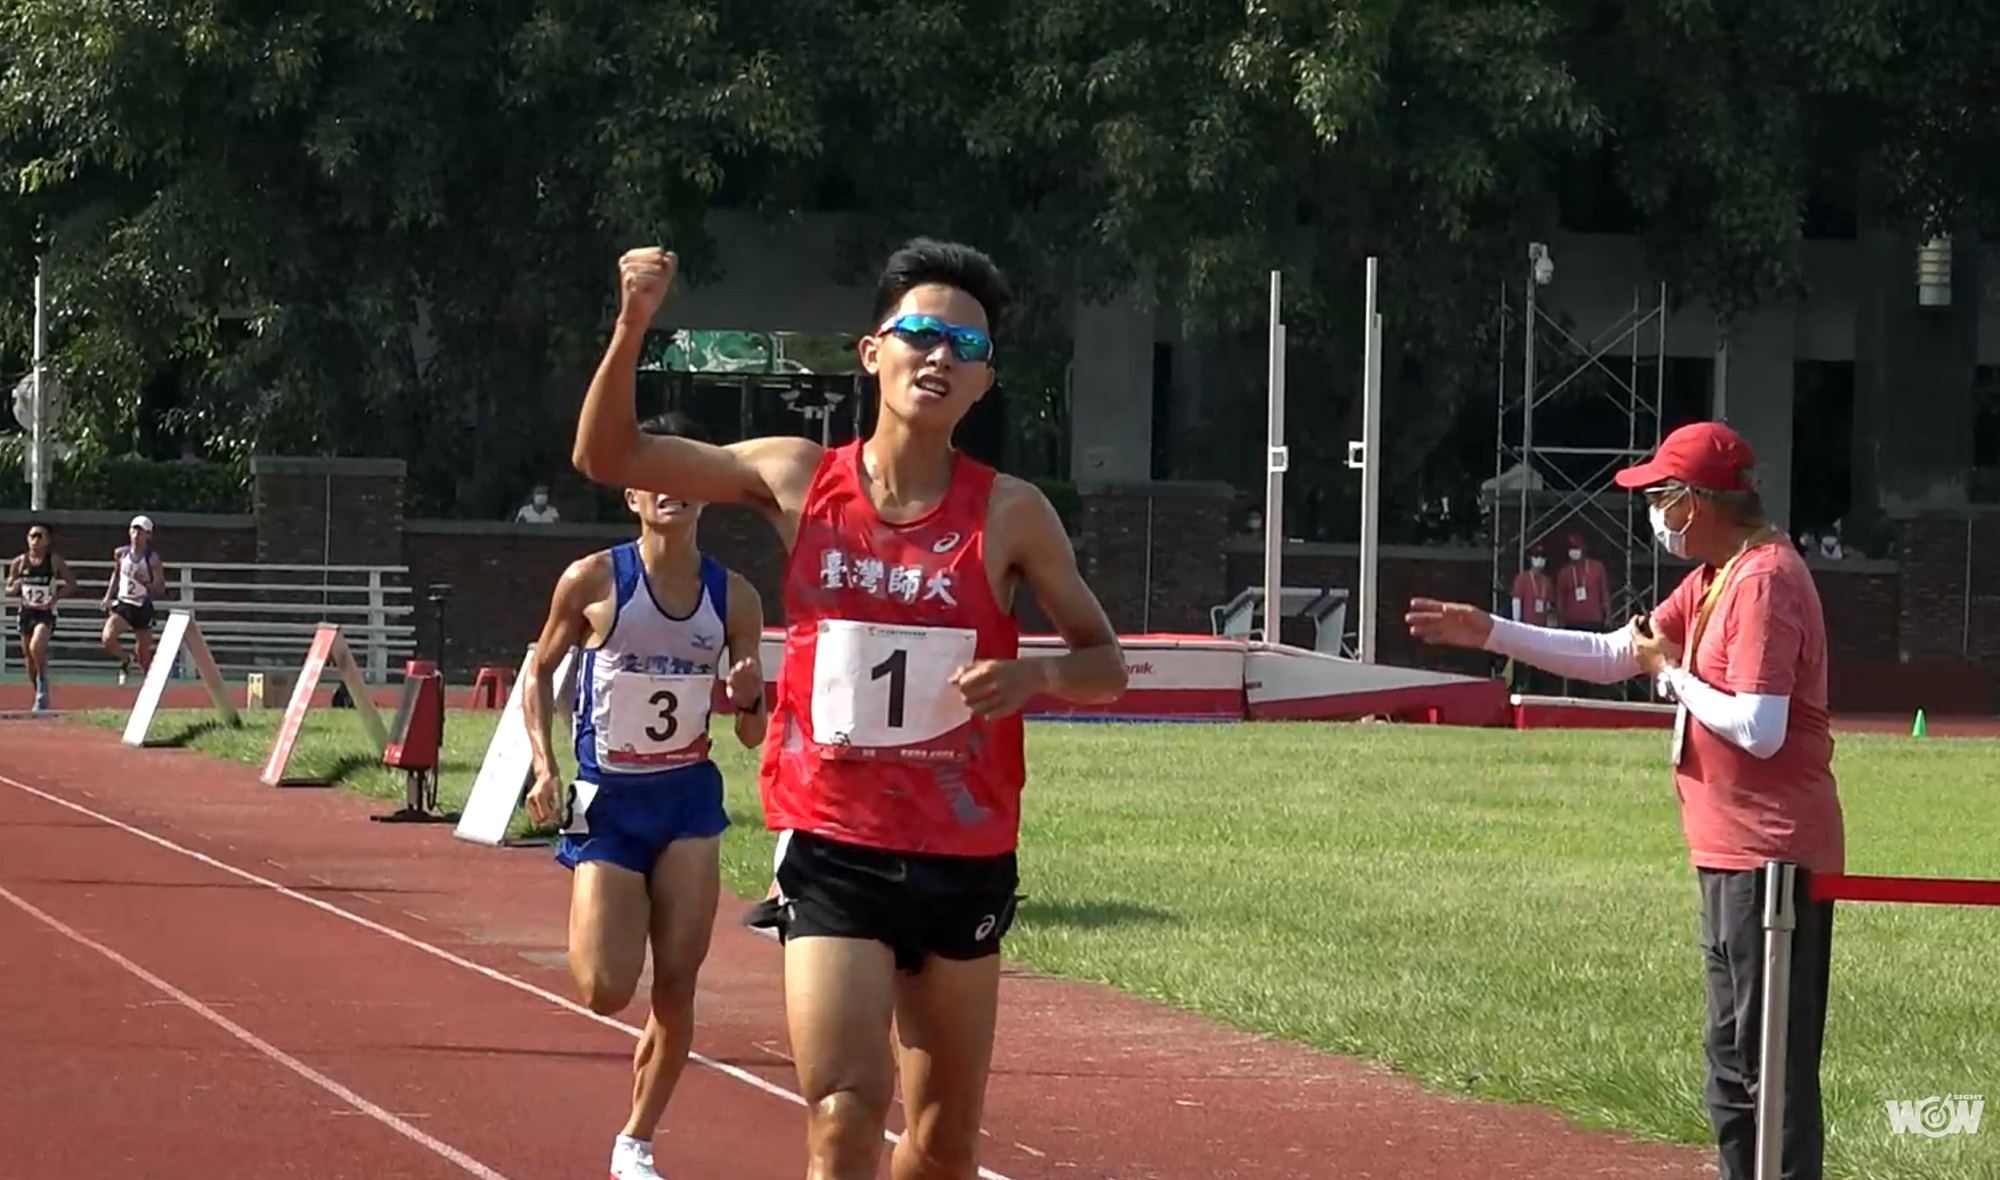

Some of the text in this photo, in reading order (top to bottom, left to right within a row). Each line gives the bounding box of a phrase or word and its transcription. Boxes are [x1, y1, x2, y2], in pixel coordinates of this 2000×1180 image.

[27, 588, 45, 604] 12
[127, 580, 136, 595] 2
[820, 549, 957, 606] 臺灣師大
[871, 648, 907, 728] 1
[645, 690, 678, 742] 3
